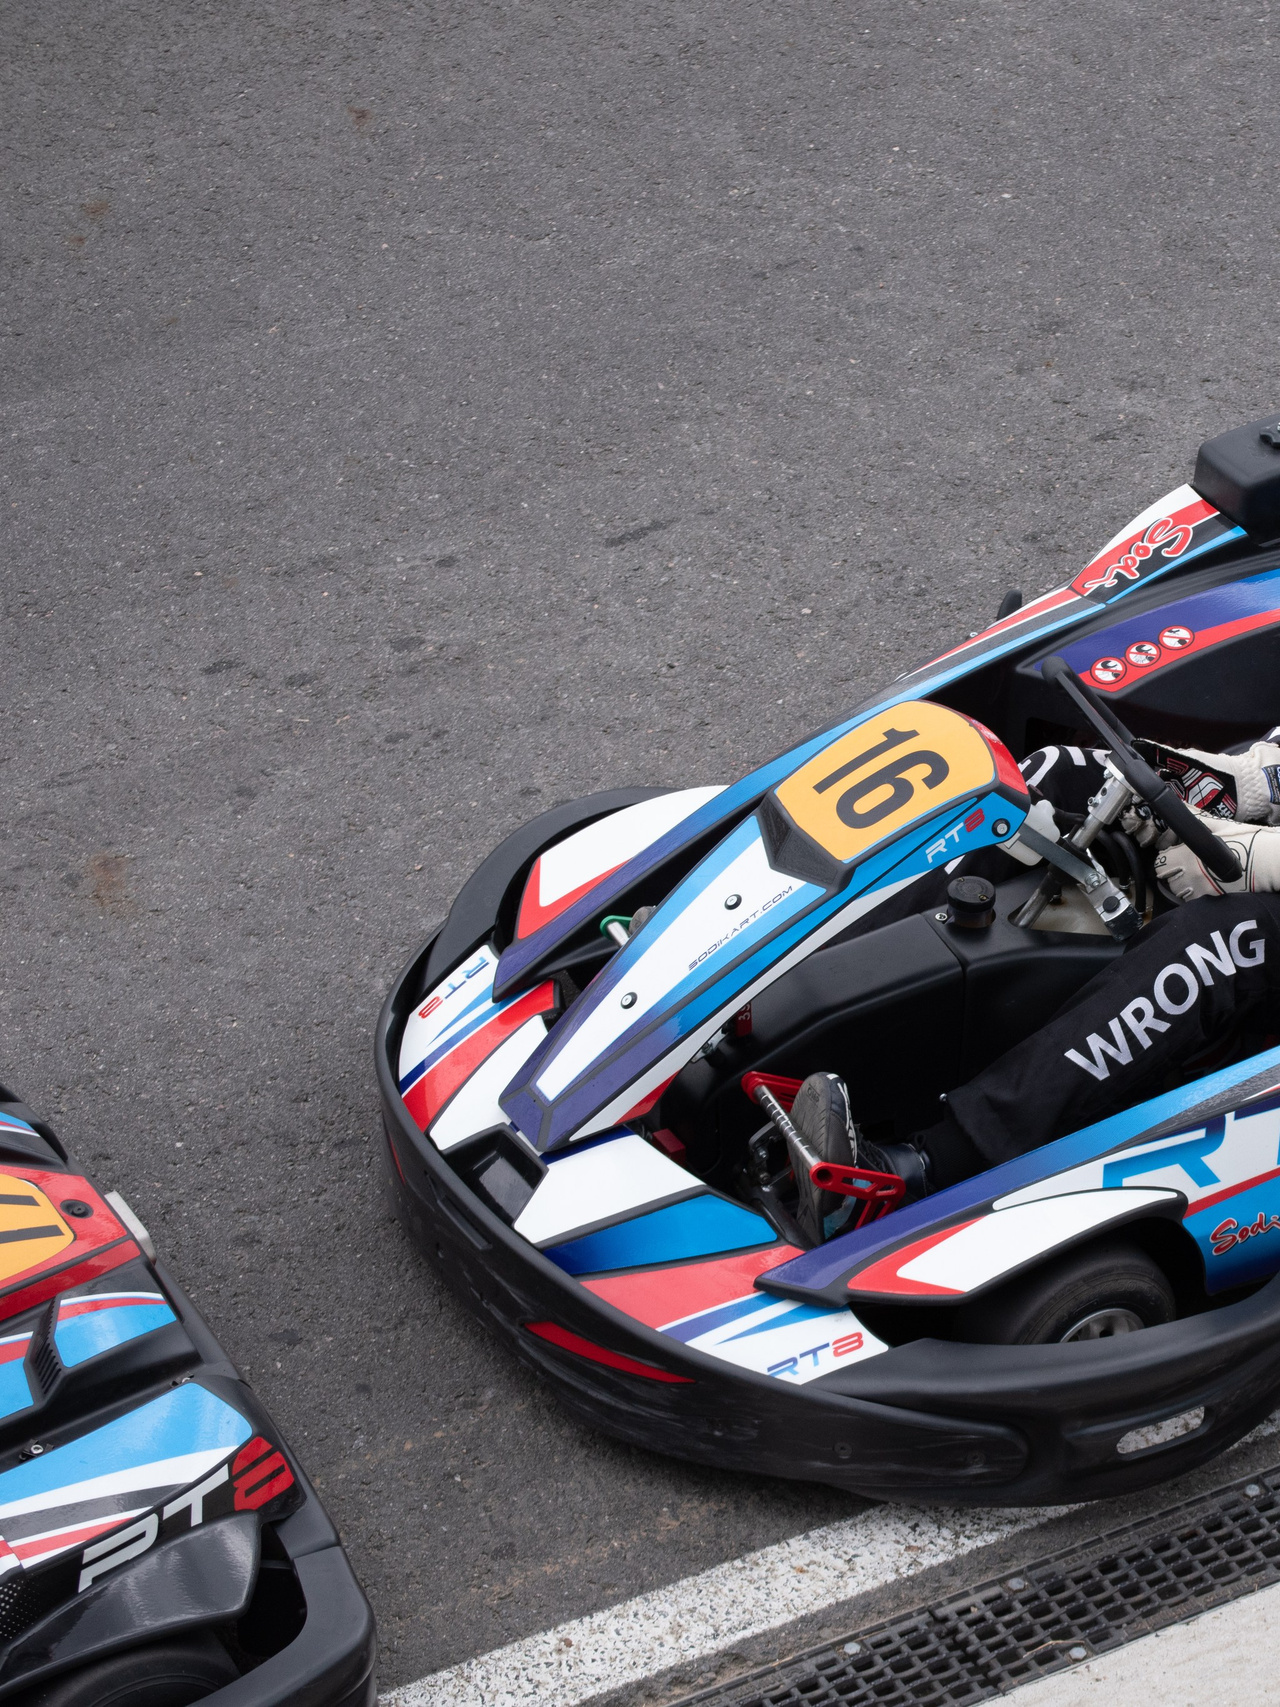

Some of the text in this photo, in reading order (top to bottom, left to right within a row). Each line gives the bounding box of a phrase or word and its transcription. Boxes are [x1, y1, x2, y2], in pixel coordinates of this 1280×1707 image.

[812, 727, 949, 829] 16
[925, 808, 985, 863] RT8
[418, 956, 489, 1019] RT8
[1064, 919, 1266, 1082] WRONG
[766, 1332, 864, 1379] RT8
